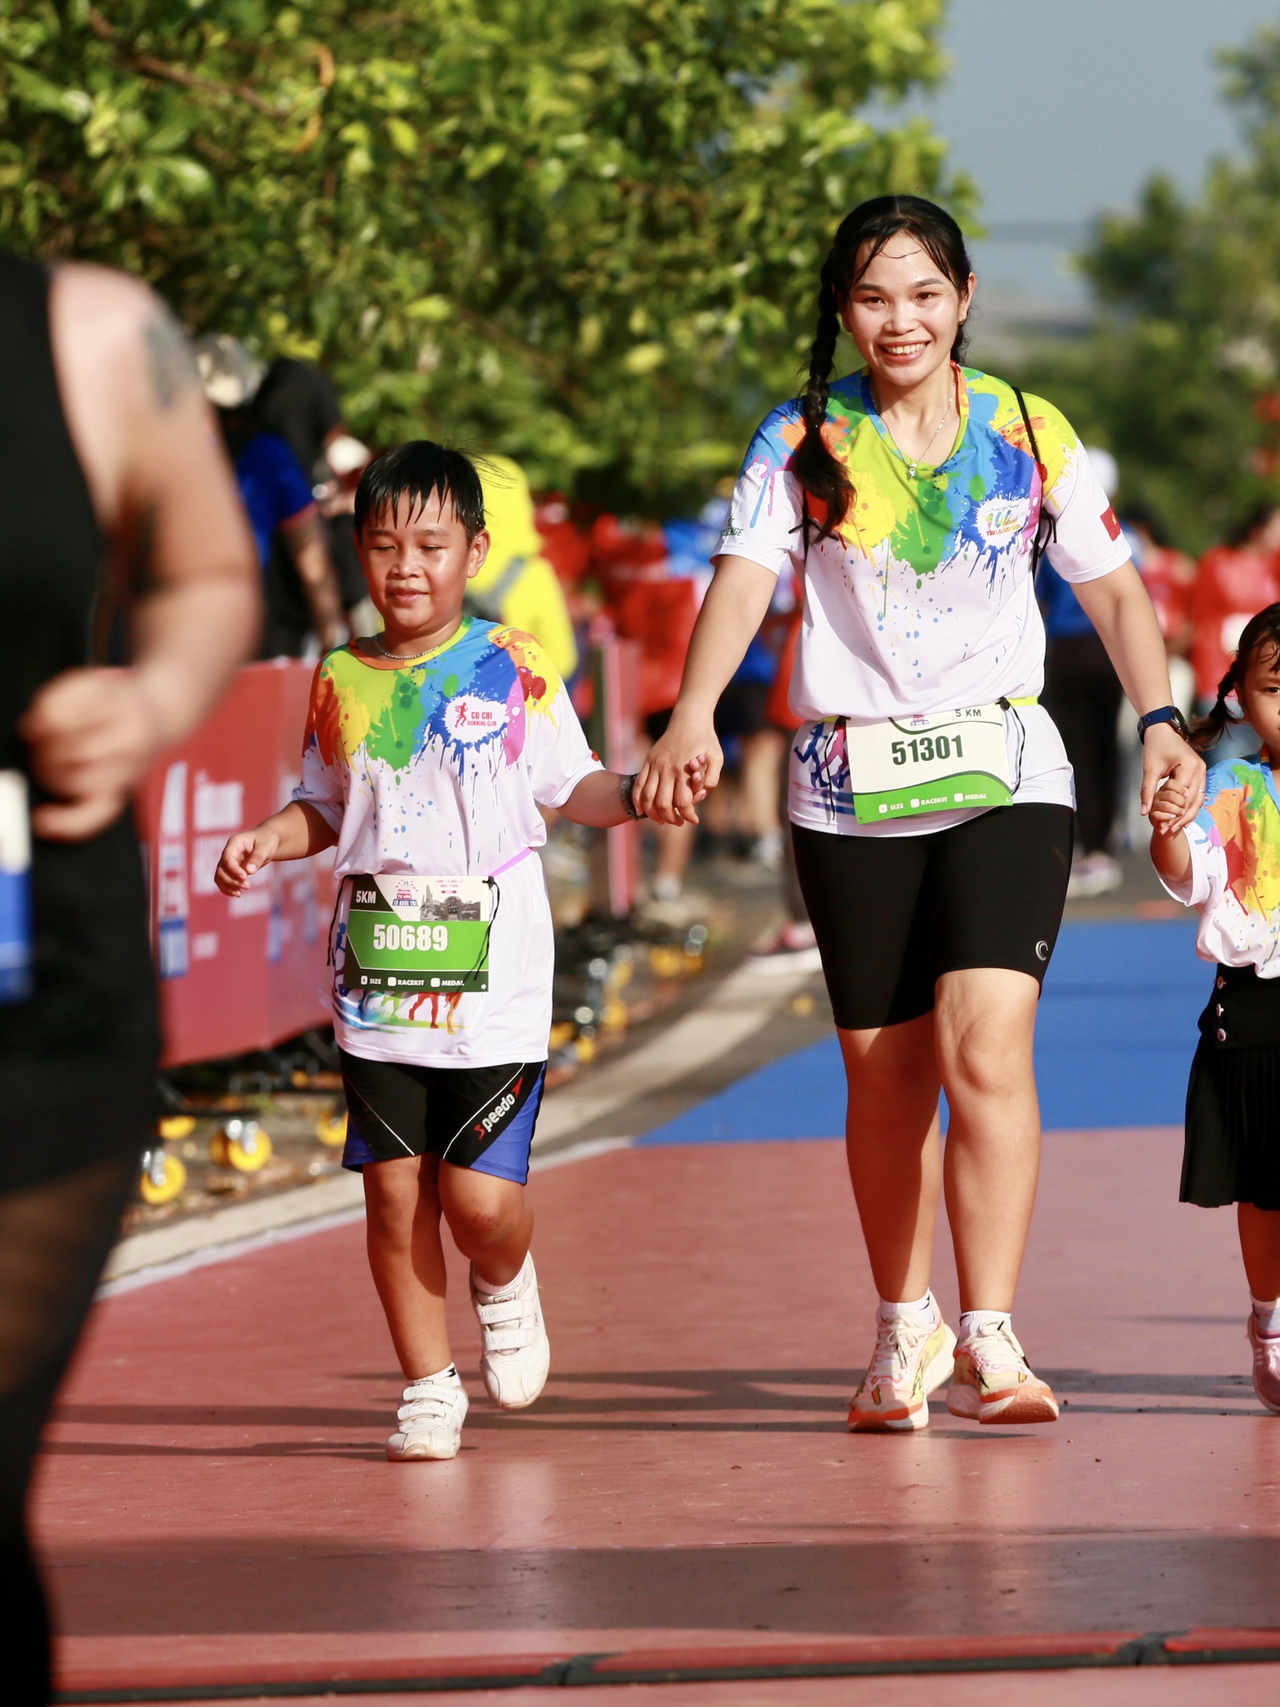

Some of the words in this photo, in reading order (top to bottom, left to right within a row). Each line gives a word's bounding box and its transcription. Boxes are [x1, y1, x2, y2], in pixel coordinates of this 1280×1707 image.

[471, 711, 480, 720] CU
[481, 711, 493, 720] CHI
[955, 709, 962, 718] 5
[965, 709, 982, 717] KM
[891, 734, 963, 766] 51301
[890, 802, 904, 811] SIZE
[920, 796, 948, 806] RACEKIT
[965, 793, 987, 801] MEDAL
[355, 890, 377, 904] 5KM
[373, 924, 449, 952] 50689
[397, 979, 425, 987] RACEKIT
